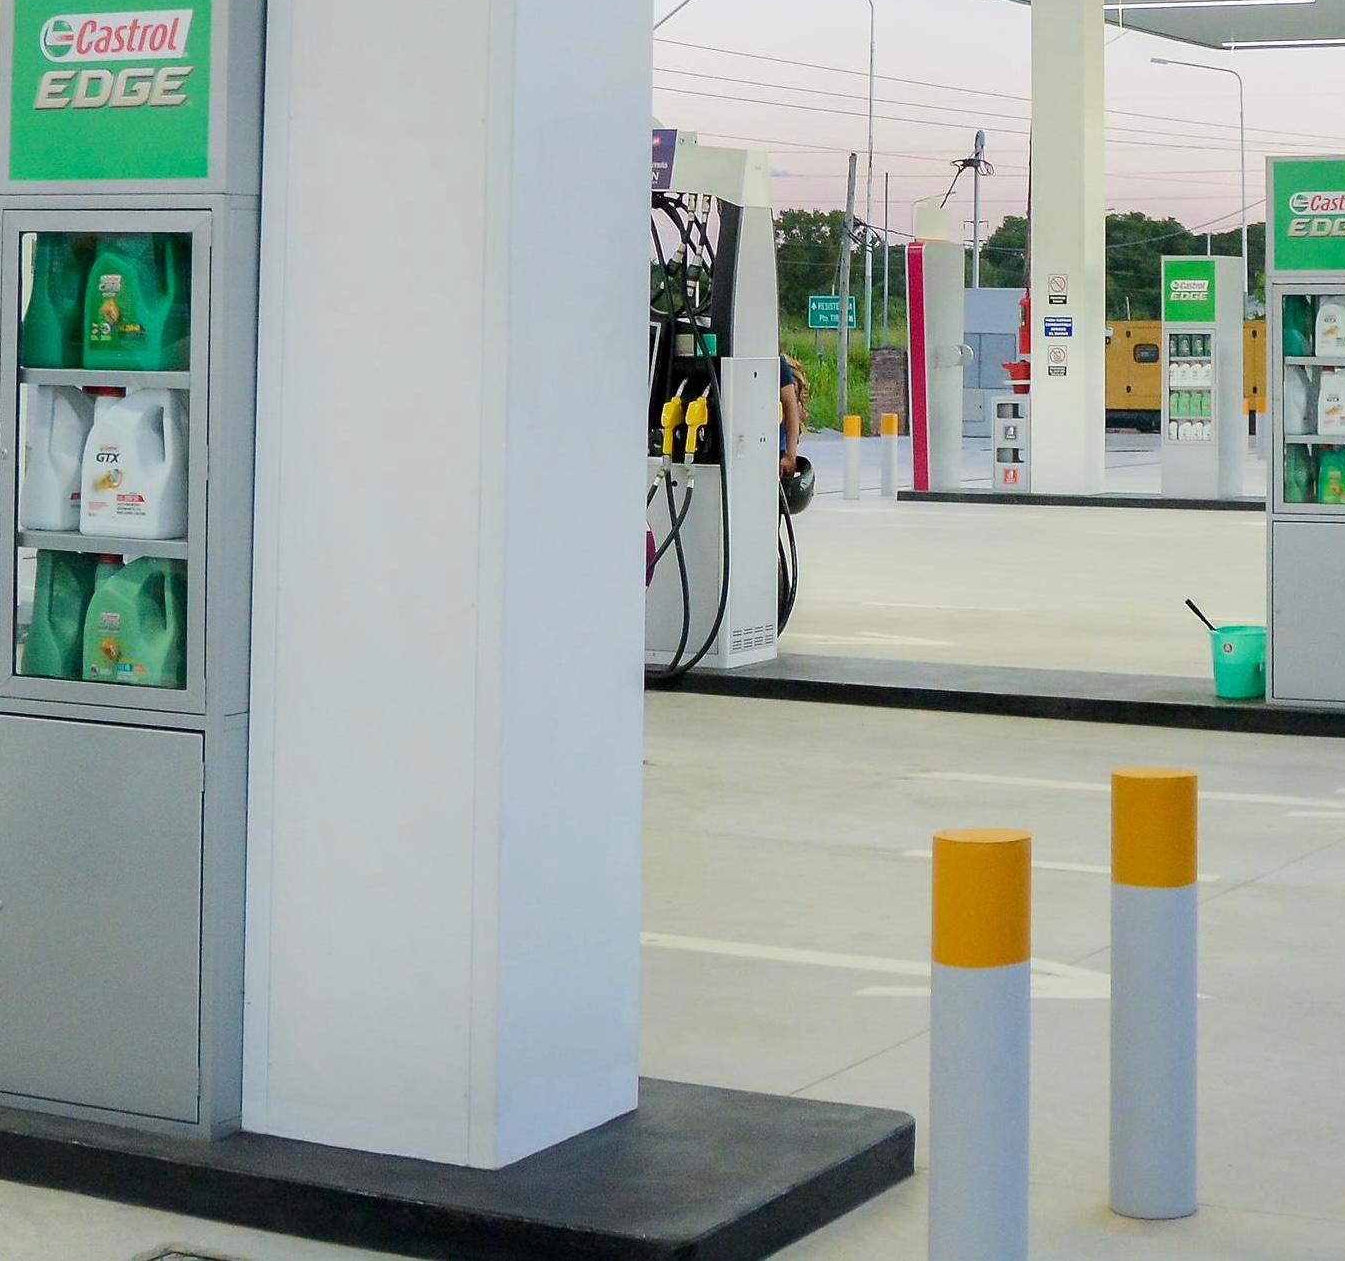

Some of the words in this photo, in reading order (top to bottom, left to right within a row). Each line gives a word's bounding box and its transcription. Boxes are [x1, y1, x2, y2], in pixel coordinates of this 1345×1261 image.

[75, 17, 180, 56] Castrol
[33, 66, 195, 110] EDGE
[96, 452, 121, 464] GTX
